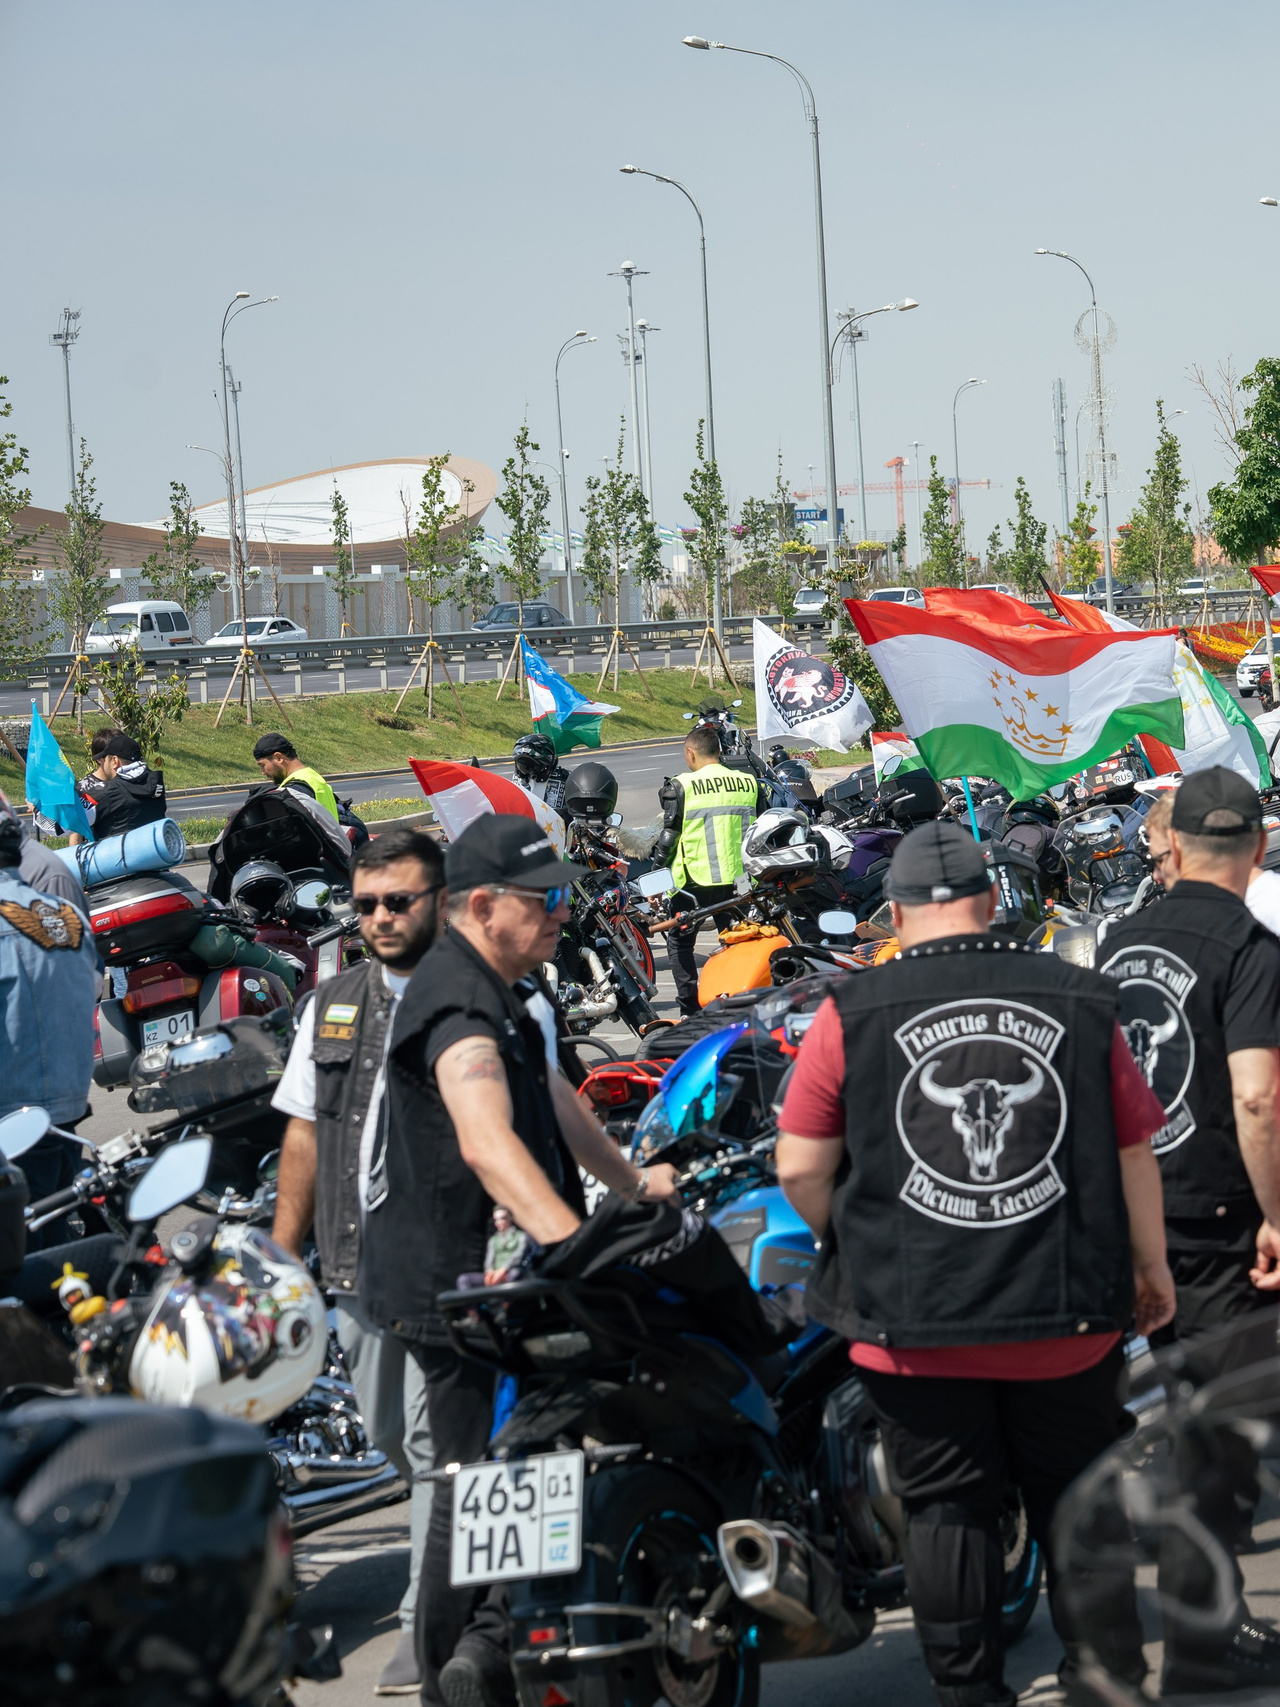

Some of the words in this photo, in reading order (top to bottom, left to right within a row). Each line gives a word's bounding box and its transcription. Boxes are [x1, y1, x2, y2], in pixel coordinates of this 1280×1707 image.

[796, 511, 820, 519] START
[691, 776, 756, 796] МАРШАЛ
[1115, 772, 1131, 784] RUS
[95, 916, 110, 927] GIVI
[141, 974, 164, 985] HONDA
[1152, 958, 1189, 997] Scull
[168, 1013, 190, 1034] 01
[903, 1013, 988, 1052] Taurus
[998, 1011, 1054, 1051] Scull
[146, 1032, 158, 1042] KZ
[461, 1467, 536, 1519] 465
[547, 1474, 573, 1498] 01
[467, 1524, 523, 1574] HA
[548, 1543, 569, 1562] UZ
